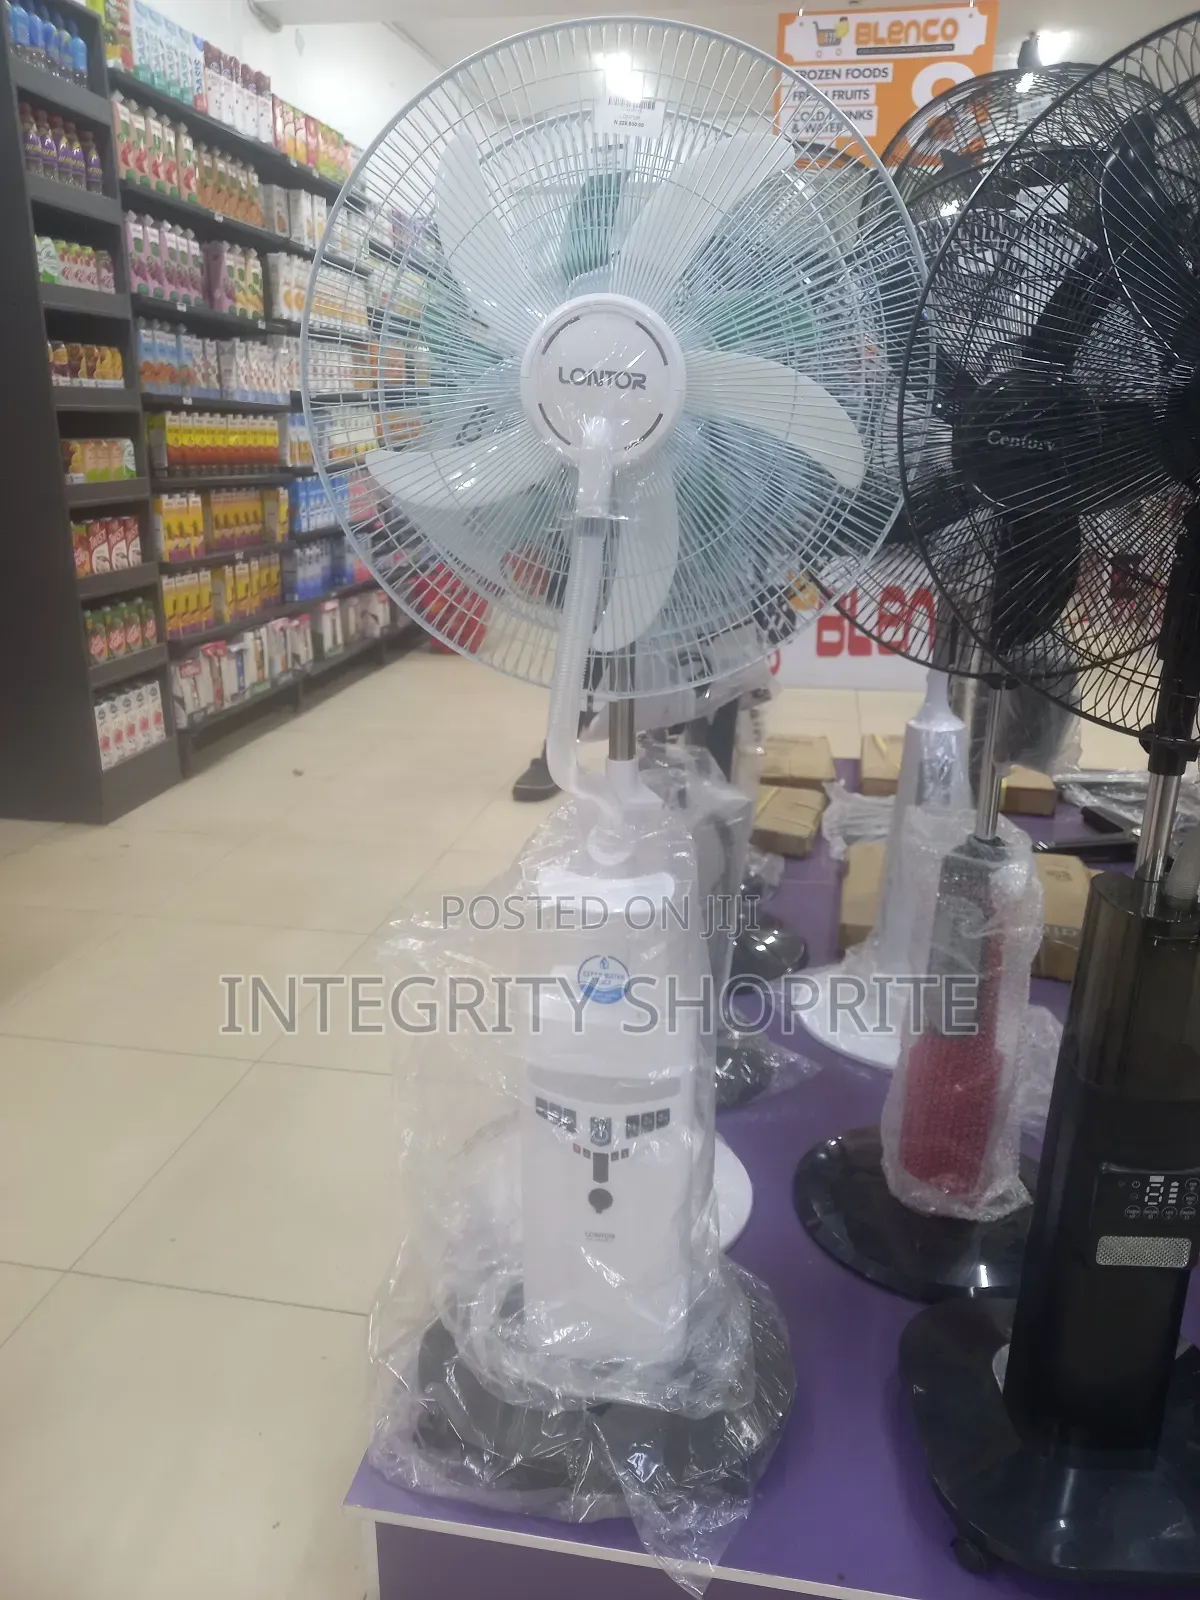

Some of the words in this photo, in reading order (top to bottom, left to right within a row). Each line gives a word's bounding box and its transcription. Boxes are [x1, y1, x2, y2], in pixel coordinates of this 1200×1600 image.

[845, 67, 889, 79] FOODS
[793, 89, 828, 101] FRE
[832, 89, 870, 100] FRUITS
[829, 109, 873, 121] INKS
[558, 366, 647, 390] LONTOR
[987, 430, 1056, 451] Century
[816, 585, 937, 657] BLEN
